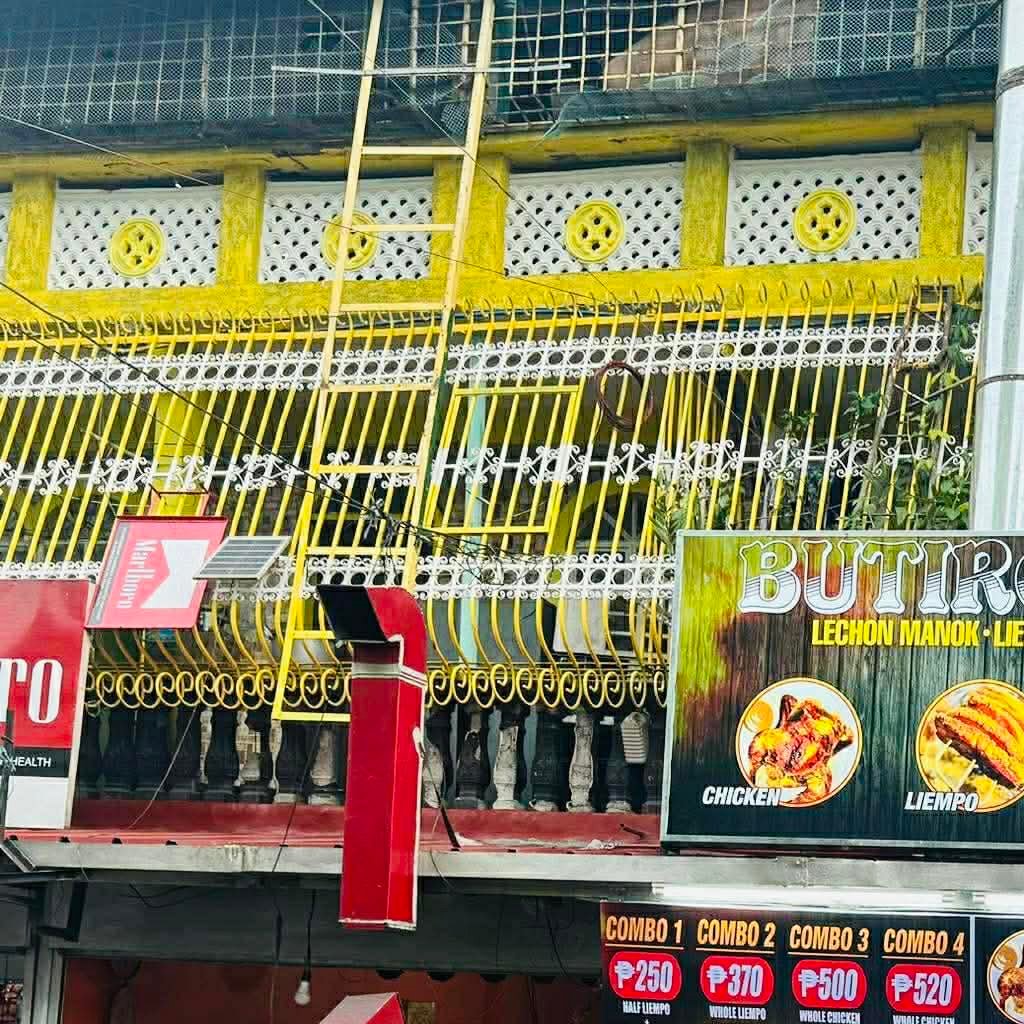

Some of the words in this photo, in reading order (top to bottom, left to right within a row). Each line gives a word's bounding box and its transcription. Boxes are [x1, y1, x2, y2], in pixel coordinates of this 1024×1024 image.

[115, 539, 159, 609] Marlboro
[811, 620, 893, 646] LECHON
[899, 620, 980, 647] MANOK
[702, 786, 781, 807] CHICKEN
[904, 791, 979, 812] LIEMPO
[605, 915, 668, 943] COMBO
[673, 919, 683, 944] 1
[697, 919, 760, 947] COMBO
[764, 922, 776, 947] 2
[789, 924, 853, 951] COMBO
[857, 928, 869, 952] 3
[883, 928, 949, 954] COMBO
[953, 932, 965, 956] 4
[622, 1000, 641, 1014] HALF
[642, 1001, 671, 1016] LIEMPO
[709, 1005, 737, 1019] WHOLE
[738, 1007, 767, 1021] LIEMPO
[799, 1010, 827, 1023] WHOLE
[828, 1011, 861, 1024] CHICKEN
